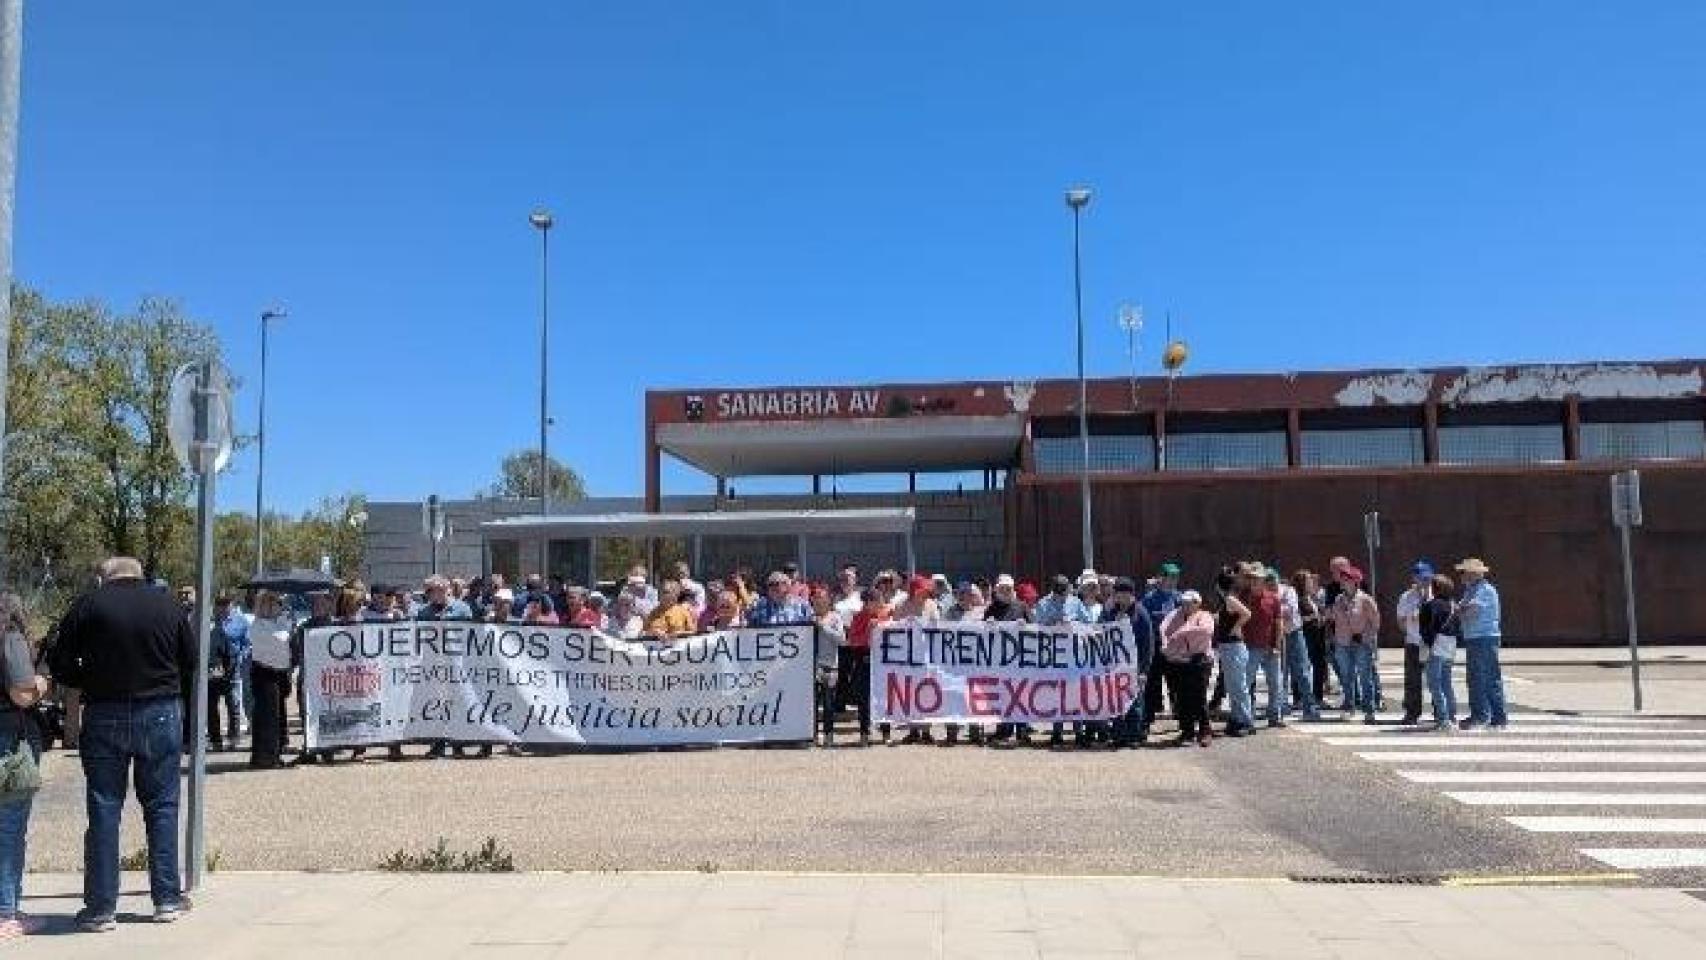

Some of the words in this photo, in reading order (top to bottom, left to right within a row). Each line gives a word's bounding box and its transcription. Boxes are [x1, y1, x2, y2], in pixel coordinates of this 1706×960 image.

[717, 390, 840, 417] SANABRIA
[849, 390, 881, 413] AV
[328, 628, 550, 660] QUEREMOS
[880, 628, 925, 666] EL
[922, 628, 996, 667] TREN
[1000, 630, 1069, 669] DEBE
[392, 665, 501, 685] DEVOLVER
[506, 667, 546, 687] LOS
[886, 672, 943, 715] NO
[466, 690, 513, 724] de
[512, 693, 661, 736] justicia
[672, 689, 784, 729] social
